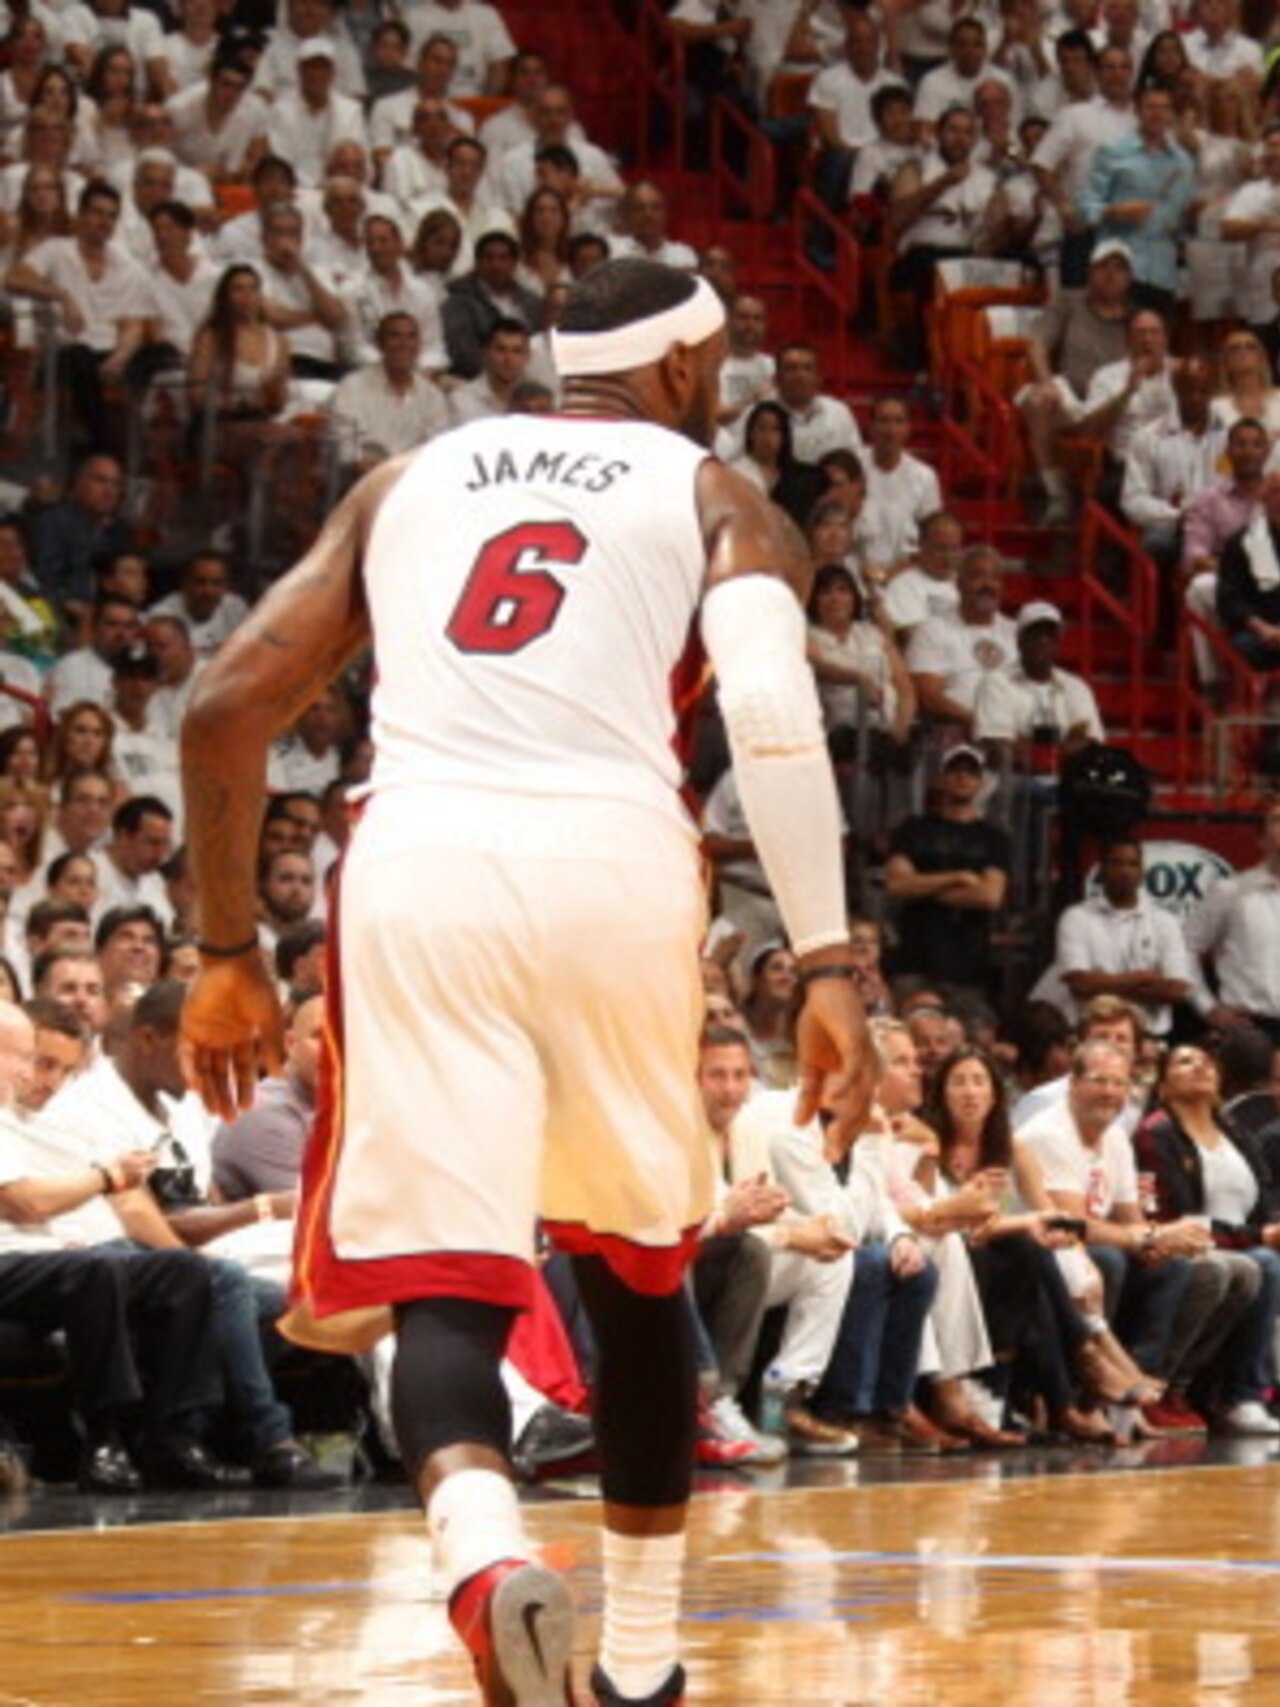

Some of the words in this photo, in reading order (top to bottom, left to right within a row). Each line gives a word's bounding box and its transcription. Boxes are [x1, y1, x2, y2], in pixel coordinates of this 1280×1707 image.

[465, 450, 631, 492] JAMES
[444, 518, 589, 655] 6
[1145, 861, 1203, 899] OX
